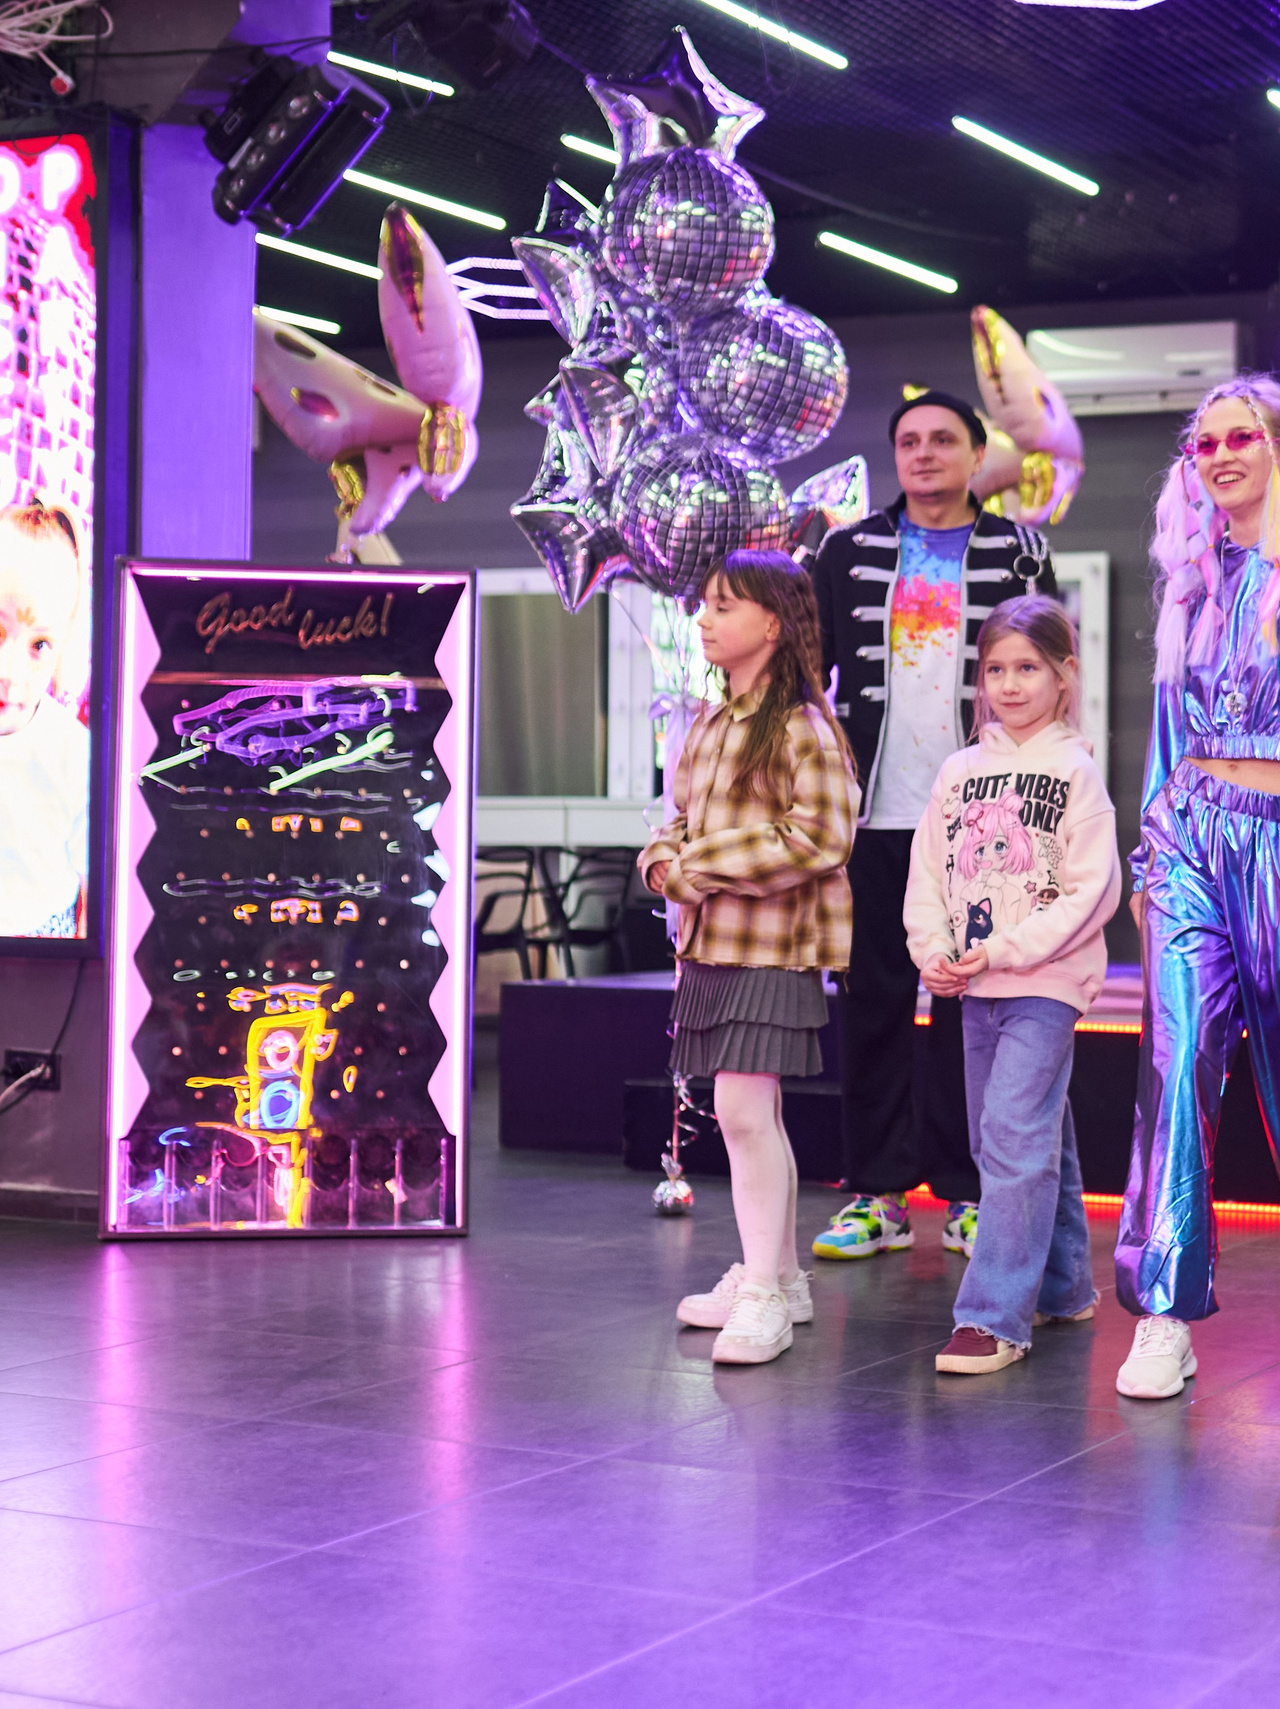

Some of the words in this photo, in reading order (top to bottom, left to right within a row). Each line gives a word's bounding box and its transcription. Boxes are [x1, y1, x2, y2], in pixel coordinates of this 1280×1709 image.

[195, 585, 296, 654] Good
[298, 592, 395, 650] luck!
[962, 772, 1012, 803] CUTE
[1014, 773, 1070, 809] VIBES
[1018, 799, 1064, 836] ONLY
